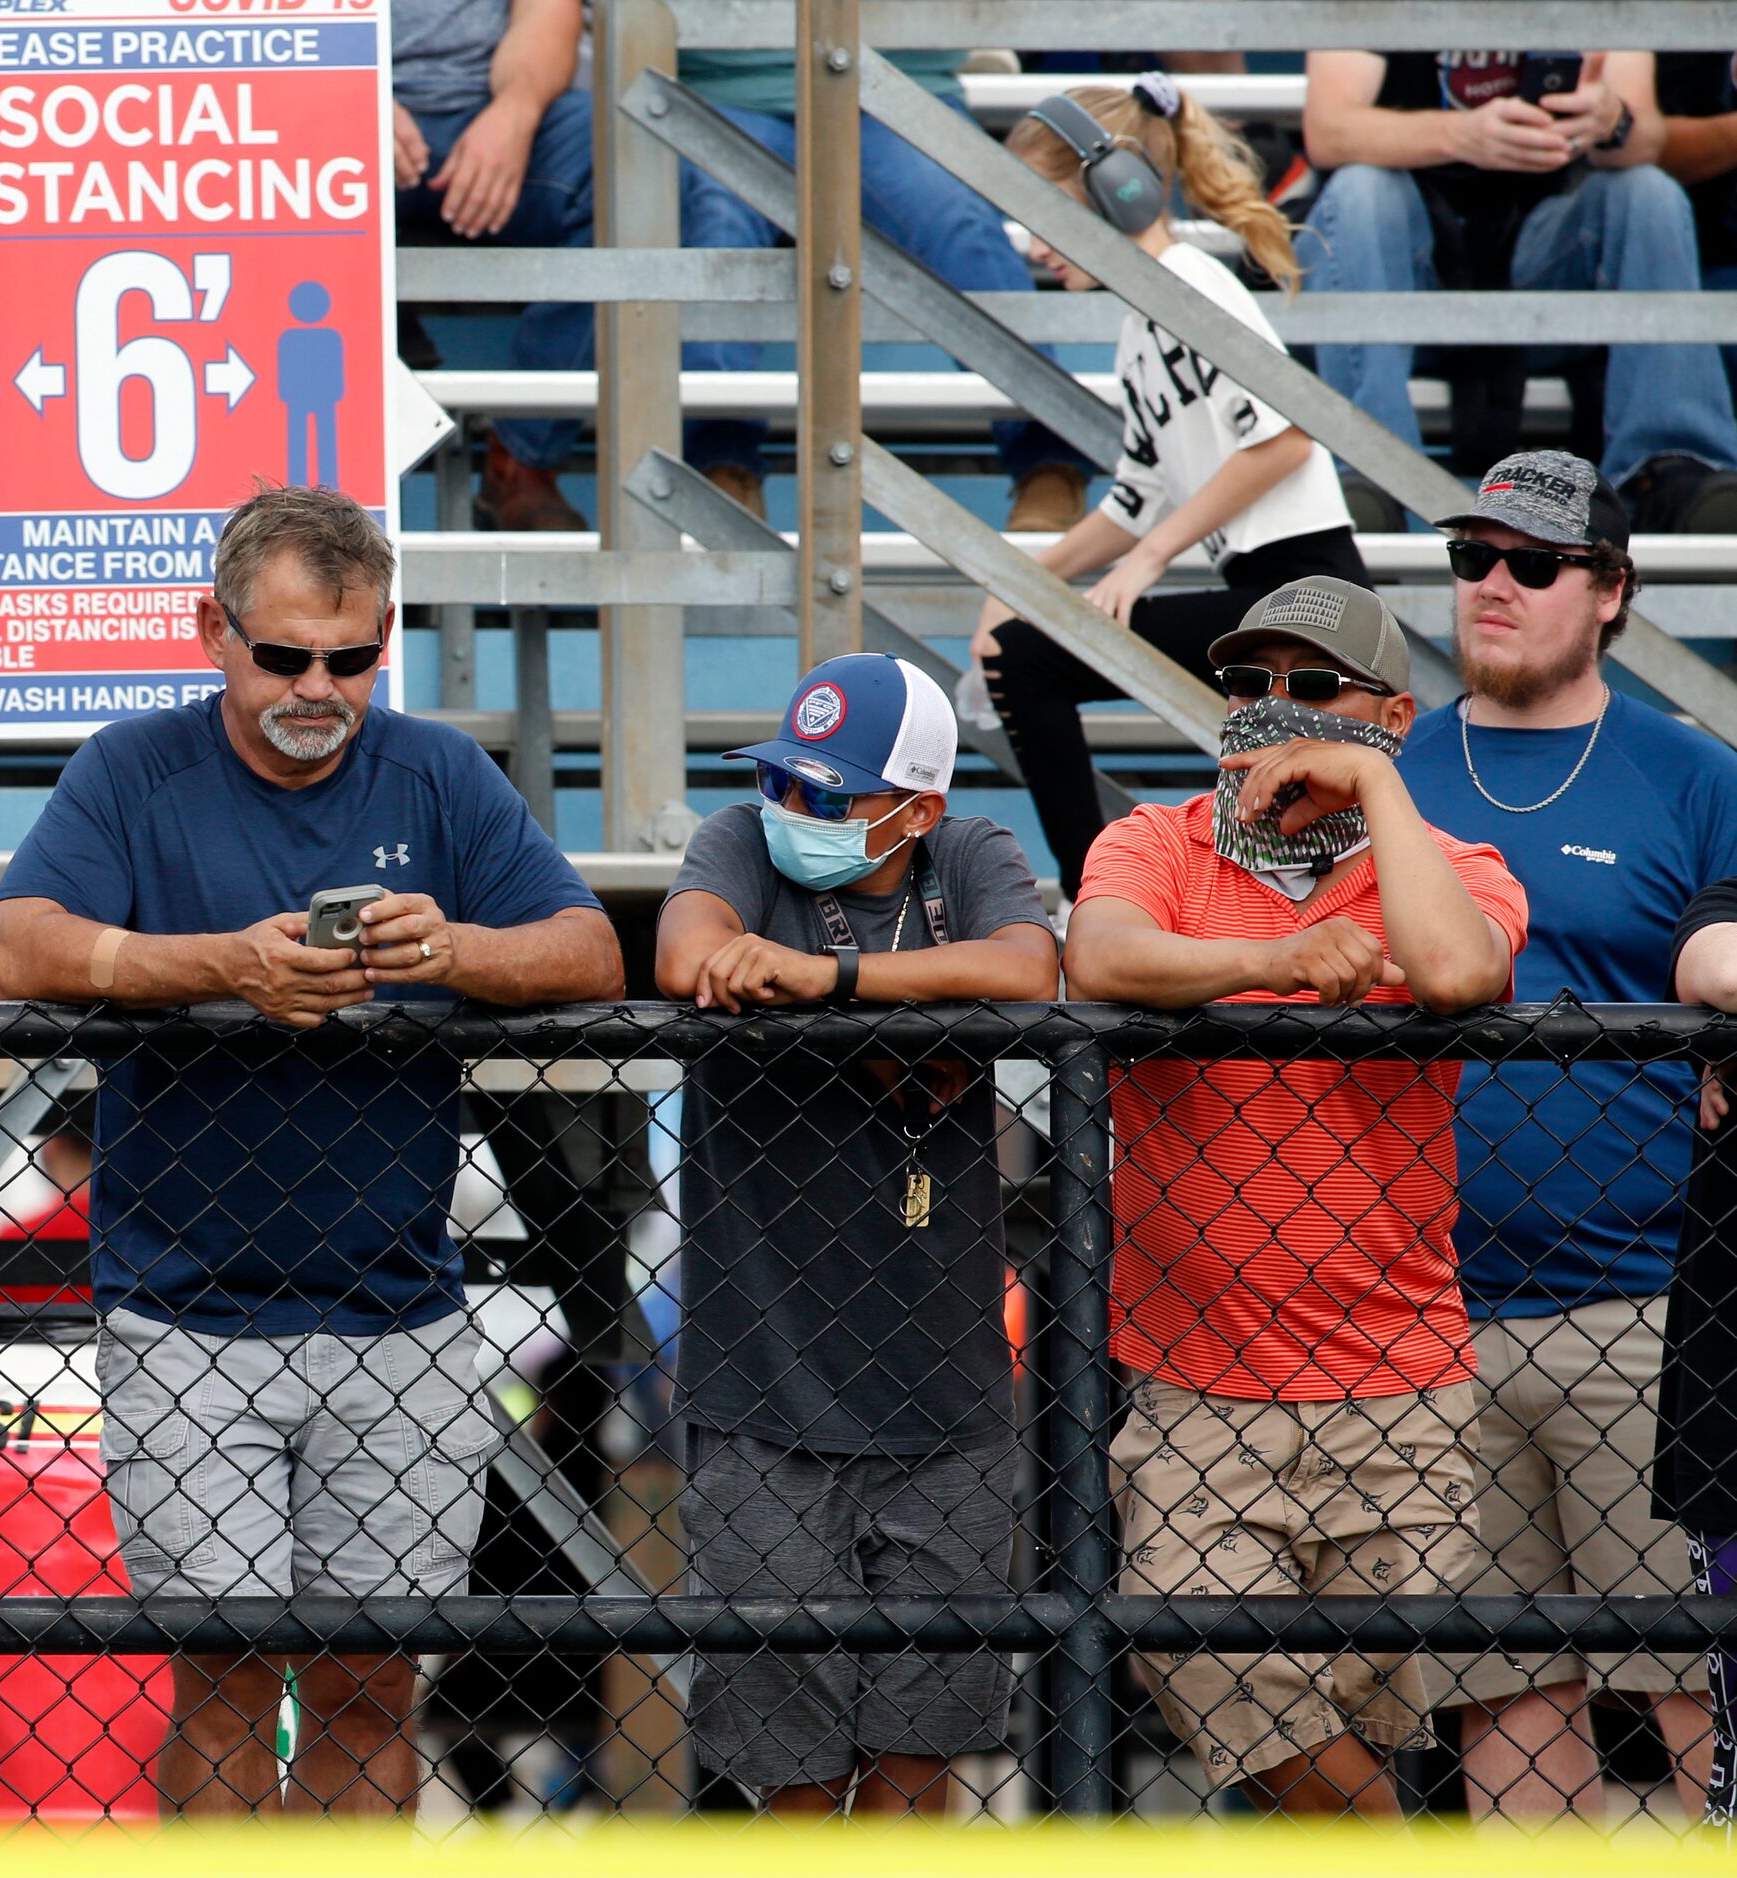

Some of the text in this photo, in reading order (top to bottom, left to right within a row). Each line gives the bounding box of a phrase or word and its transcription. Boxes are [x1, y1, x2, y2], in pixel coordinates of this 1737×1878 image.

[114, 29, 320, 64] PRACTICE
[75, 249, 231, 500] 6'
[1490, 467, 1576, 499] TRACKER
[23, 517, 215, 547] MAINTAIN A
[104, 550, 202, 579] FROM
[8, 617, 165, 643] DISTANCING
[172, 617, 197, 640] IS
[72, 685, 175, 710] HANDS
[1571, 845, 1617, 861] Columbia
